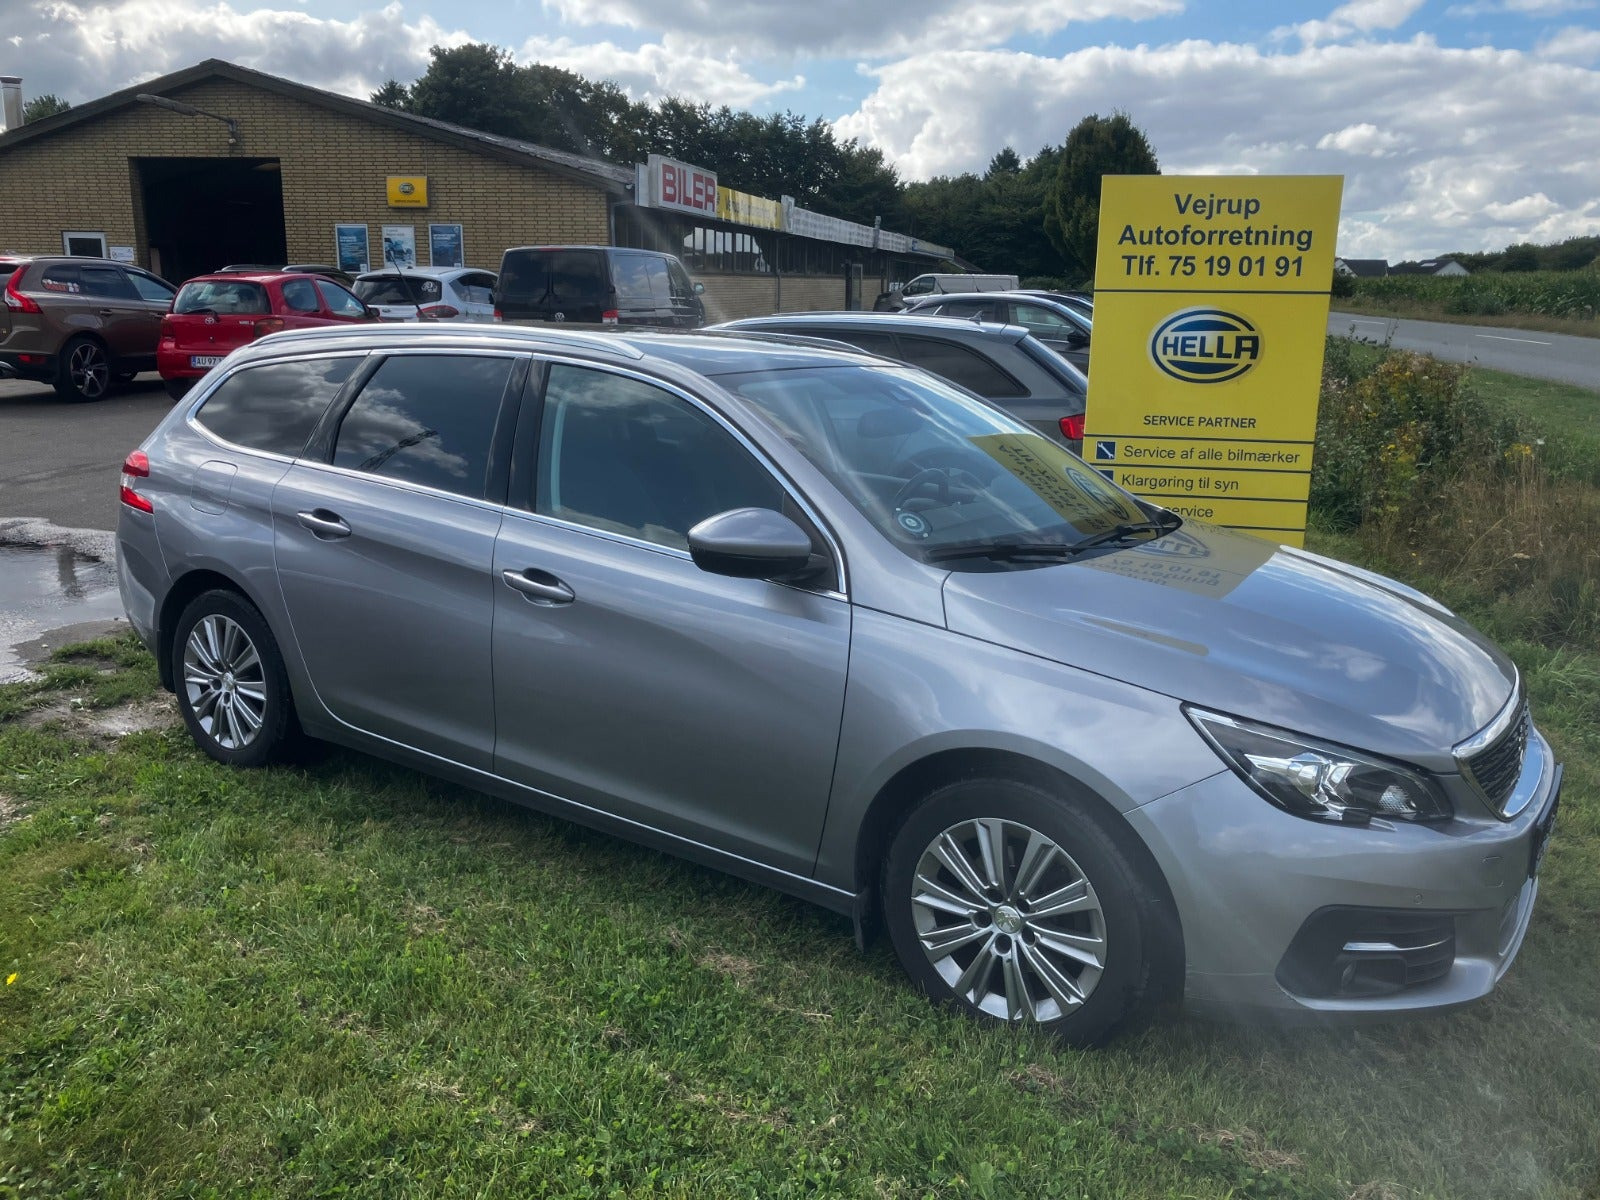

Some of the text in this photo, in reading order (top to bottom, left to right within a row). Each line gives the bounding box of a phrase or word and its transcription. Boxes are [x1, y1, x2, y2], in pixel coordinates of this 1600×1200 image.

[662, 164, 716, 212] BILER
[1174, 193, 1260, 220] Vejrup
[1117, 224, 1313, 252] Autoforretning
[1121, 255, 1303, 277] Tlf. 75 19 01 91
[1162, 335, 1259, 360] HELLA
[1143, 415, 1257, 429] SERVICE PARTNER
[1123, 445, 1300, 463] Service af alle bilmærker
[1121, 474, 1239, 491] Klargøring til syn
